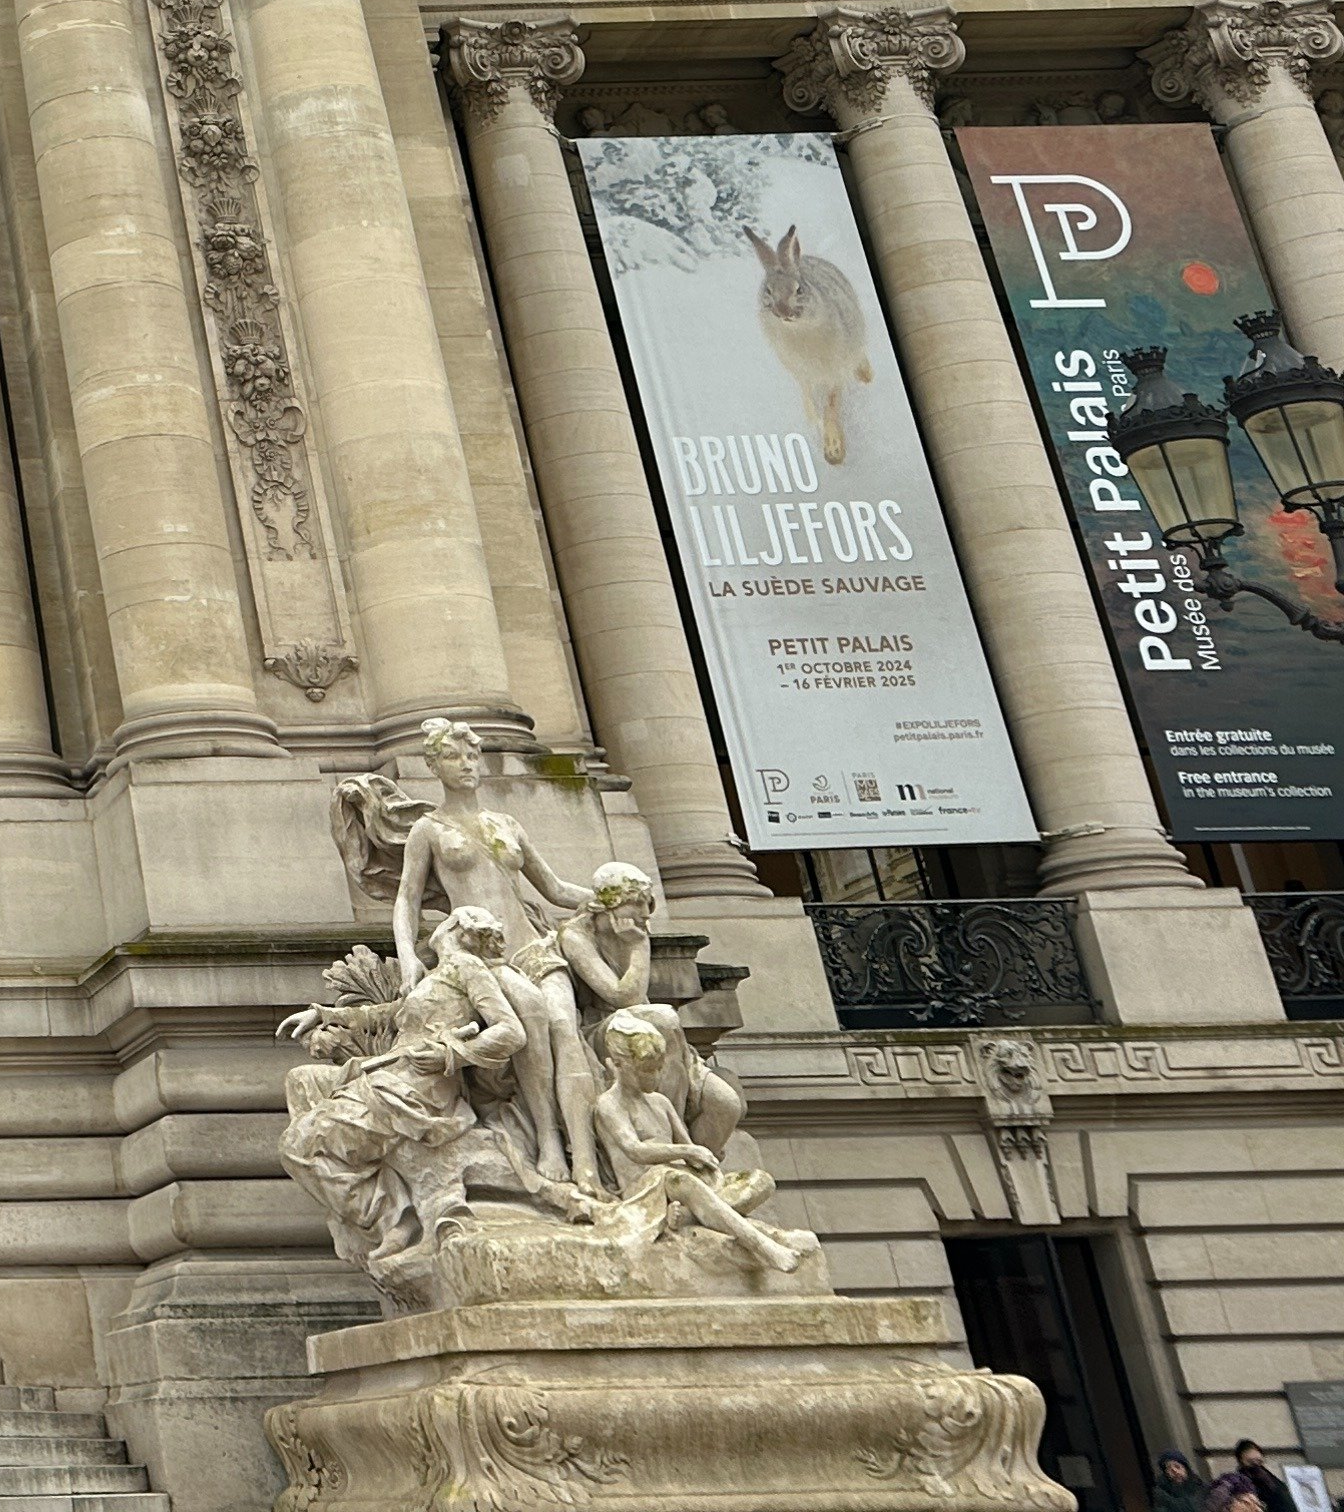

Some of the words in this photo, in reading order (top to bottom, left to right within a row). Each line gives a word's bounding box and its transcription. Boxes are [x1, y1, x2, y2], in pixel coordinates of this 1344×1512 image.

[1102, 349, 1132, 397] Paris
[1053, 349, 1141, 511] Palais
[674, 432, 819, 496] BRUNO
[689, 499, 914, 568] LILJEFORS
[1170, 553, 1194, 592] des
[708, 580, 737, 597] LA
[742, 575, 816, 596] SUÈDE
[821, 575, 927, 594] SAUVAGE
[1104, 531, 1193, 671] Petit
[768, 637, 829, 655] PETIT
[836, 634, 914, 653] PALAIS
[1183, 598, 1222, 670] Musée
[801, 661, 873, 674] OCTOBRE
[876, 660, 913, 672] 2024
[793, 678, 810, 690] 16
[815, 675, 877, 689] FÉVRIER
[881, 675, 916, 687] 2025
[893, 729, 983, 743] petitpalais.paris.fr
[1165, 727, 1213, 742] Entrée
[1216, 727, 1273, 744] gratuite
[1170, 744, 1198, 756] dans
[1199, 744, 1217, 756] les
[1218, 744, 1278, 756] collections
[1279, 743, 1295, 755] du
[1297, 742, 1335, 755] musée
[1177, 771, 1211, 784] Free
[1214, 770, 1278, 784] entrance
[810, 794, 840, 804] PARIS
[1182, 787, 1195, 798] in
[1196, 787, 1215, 798] the
[1217, 787, 1276, 798] museum's
[1278, 786, 1332, 797] collection
